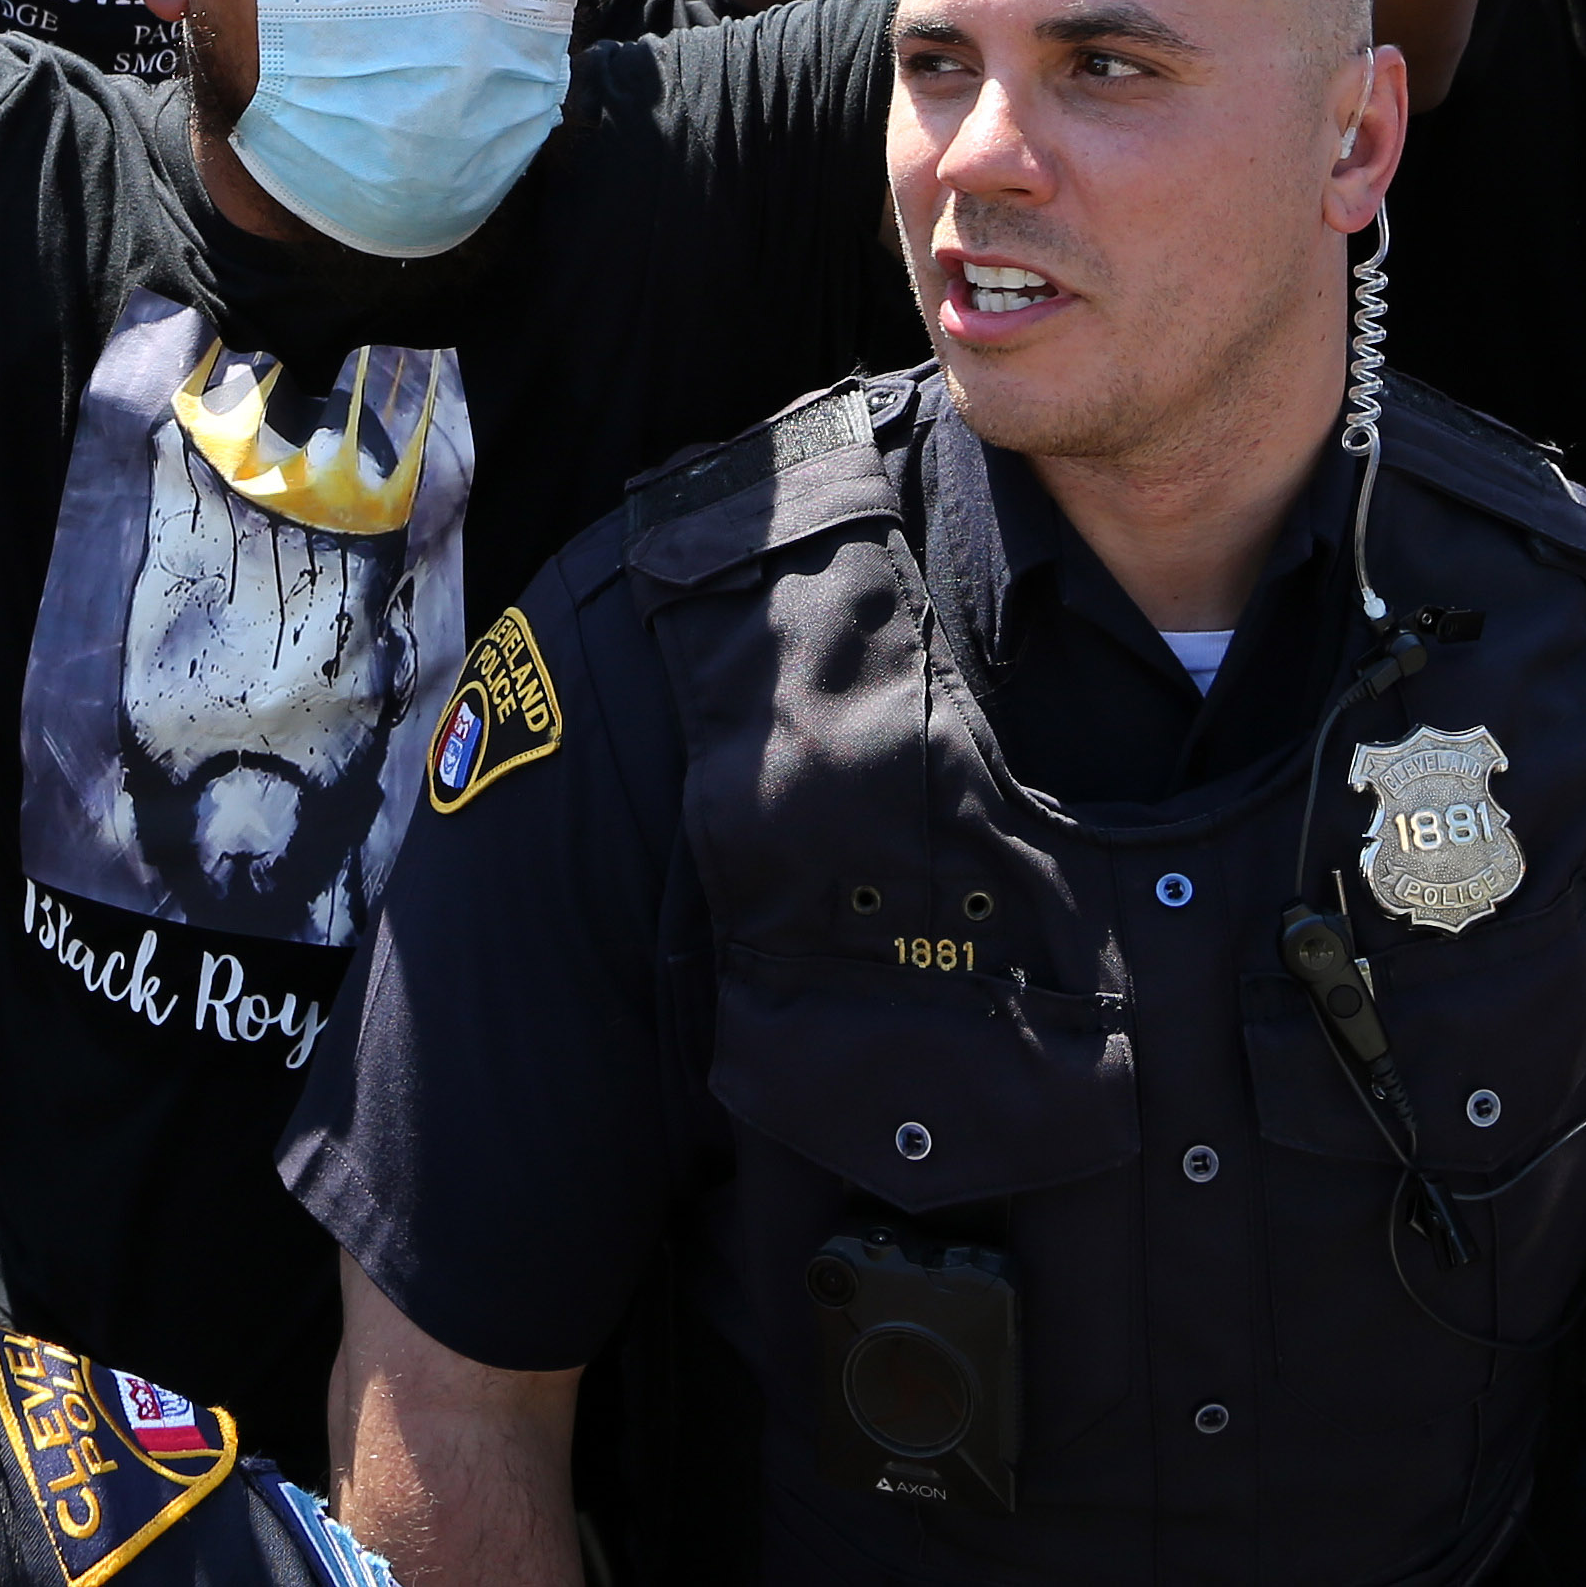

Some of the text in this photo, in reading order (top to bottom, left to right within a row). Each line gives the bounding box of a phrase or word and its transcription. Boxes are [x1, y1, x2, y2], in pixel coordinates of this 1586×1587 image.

[474, 643, 518, 725] POLICE
[488, 616, 551, 733] LEVELAND
[1382, 753, 1483, 793] CLEVELAND
[1394, 800, 1494, 855] 1881
[1403, 868, 1501, 906] POLICE
[23, 877, 179, 1026] Black
[894, 937, 975, 971] 1881
[896, 1480, 947, 1502] AXON
